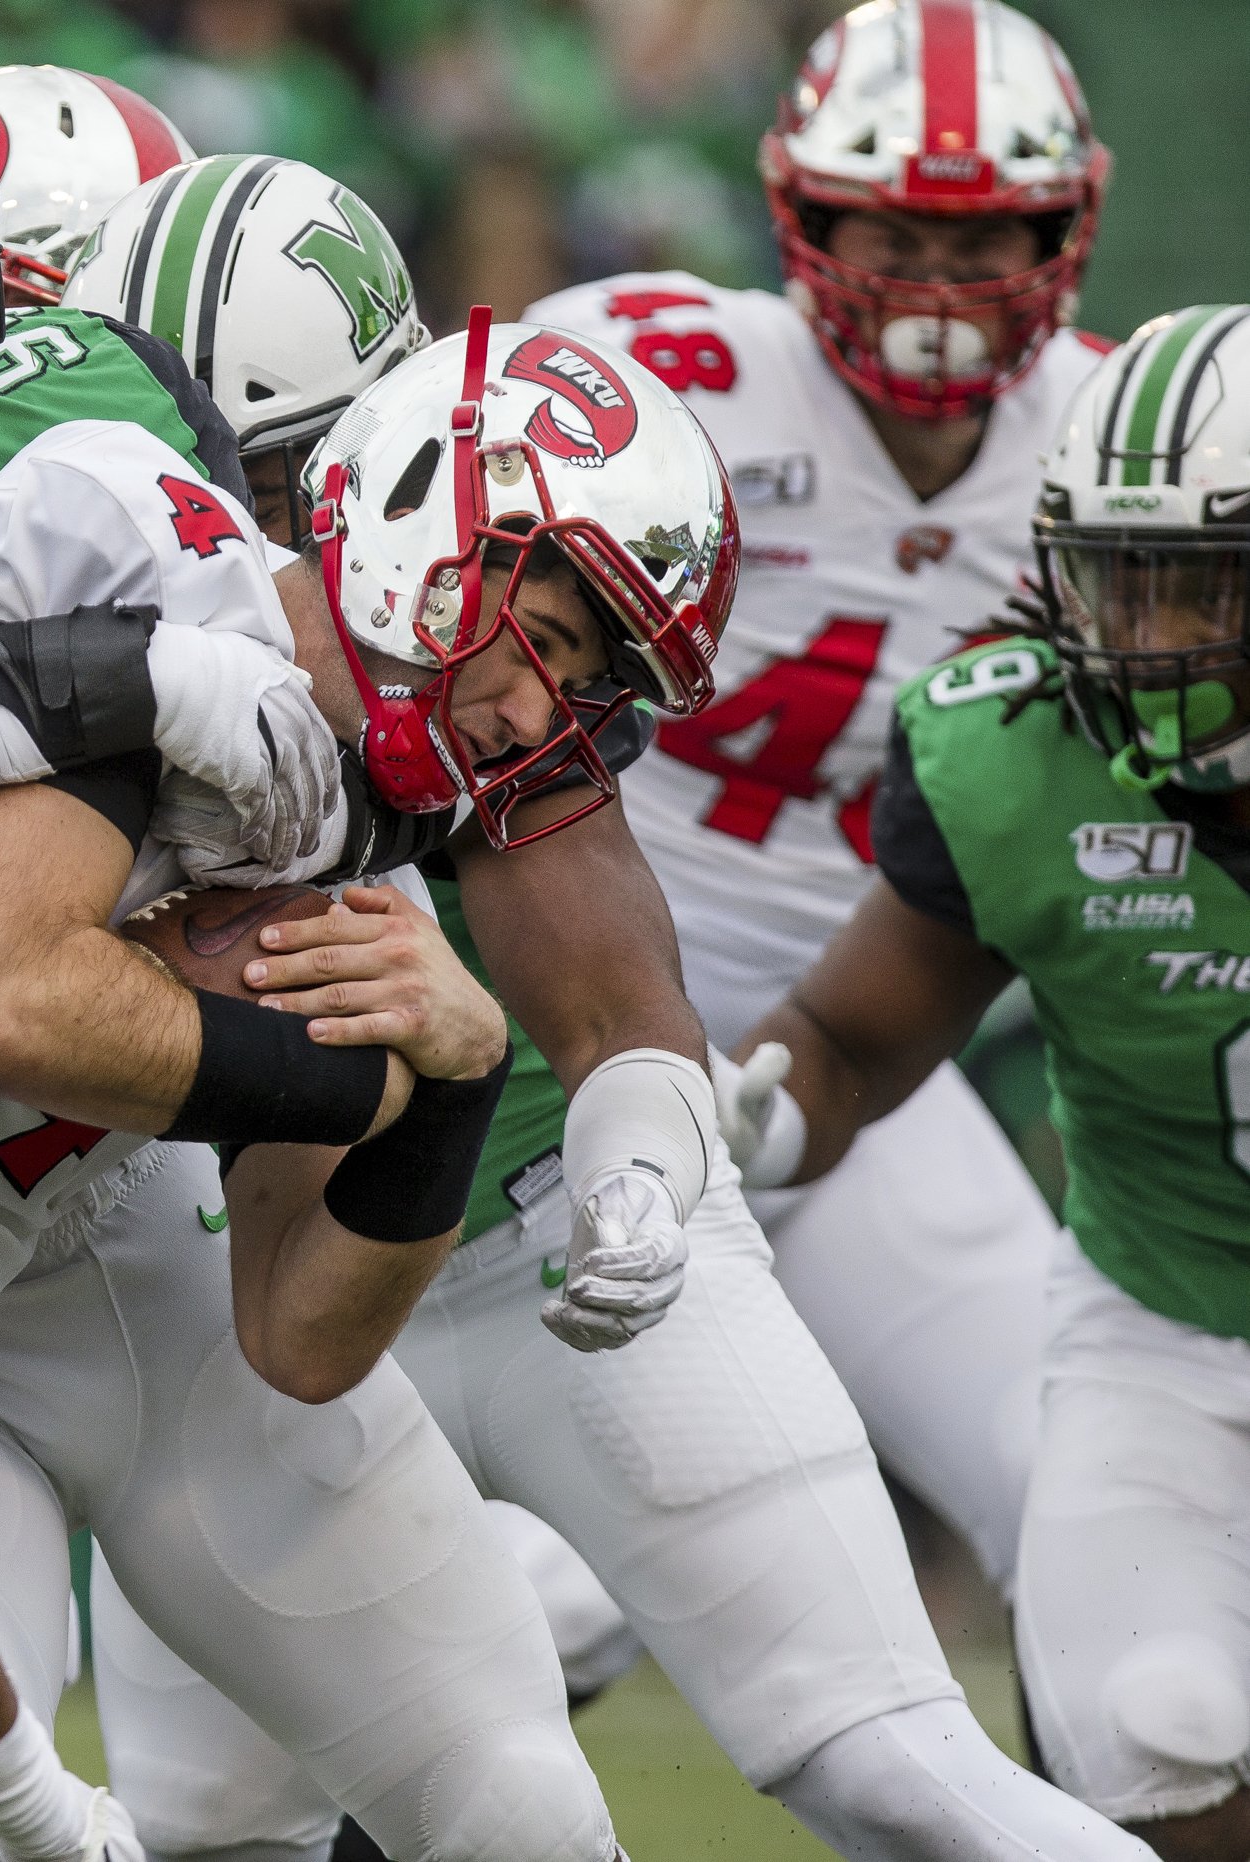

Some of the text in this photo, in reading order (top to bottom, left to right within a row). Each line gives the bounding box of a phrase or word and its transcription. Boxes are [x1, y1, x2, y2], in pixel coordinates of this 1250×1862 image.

[281, 185, 415, 365] M
[537, 346, 627, 409] WKU
[729, 454, 817, 510] 50
[156, 473, 248, 560] 4
[691, 623, 717, 662] WKU
[926, 648, 1041, 707] 9
[1076, 823, 1192, 881] 150
